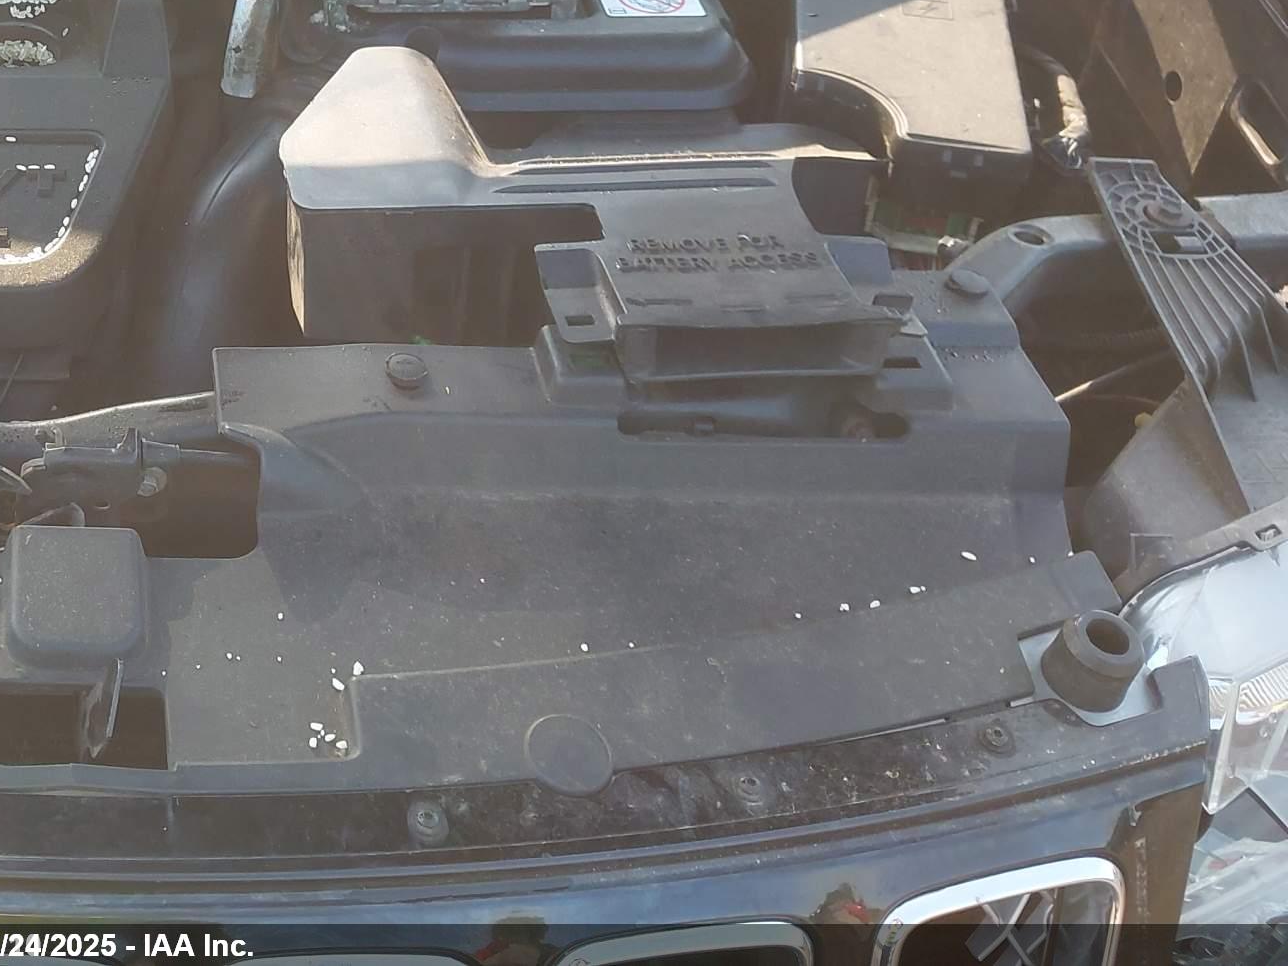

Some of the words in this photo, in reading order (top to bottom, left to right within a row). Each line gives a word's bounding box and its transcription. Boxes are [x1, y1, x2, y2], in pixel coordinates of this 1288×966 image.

[626, 236, 730, 254] REMOVE
[615, 257, 717, 273] BATTERY
[727, 251, 820, 270] ACCESS
